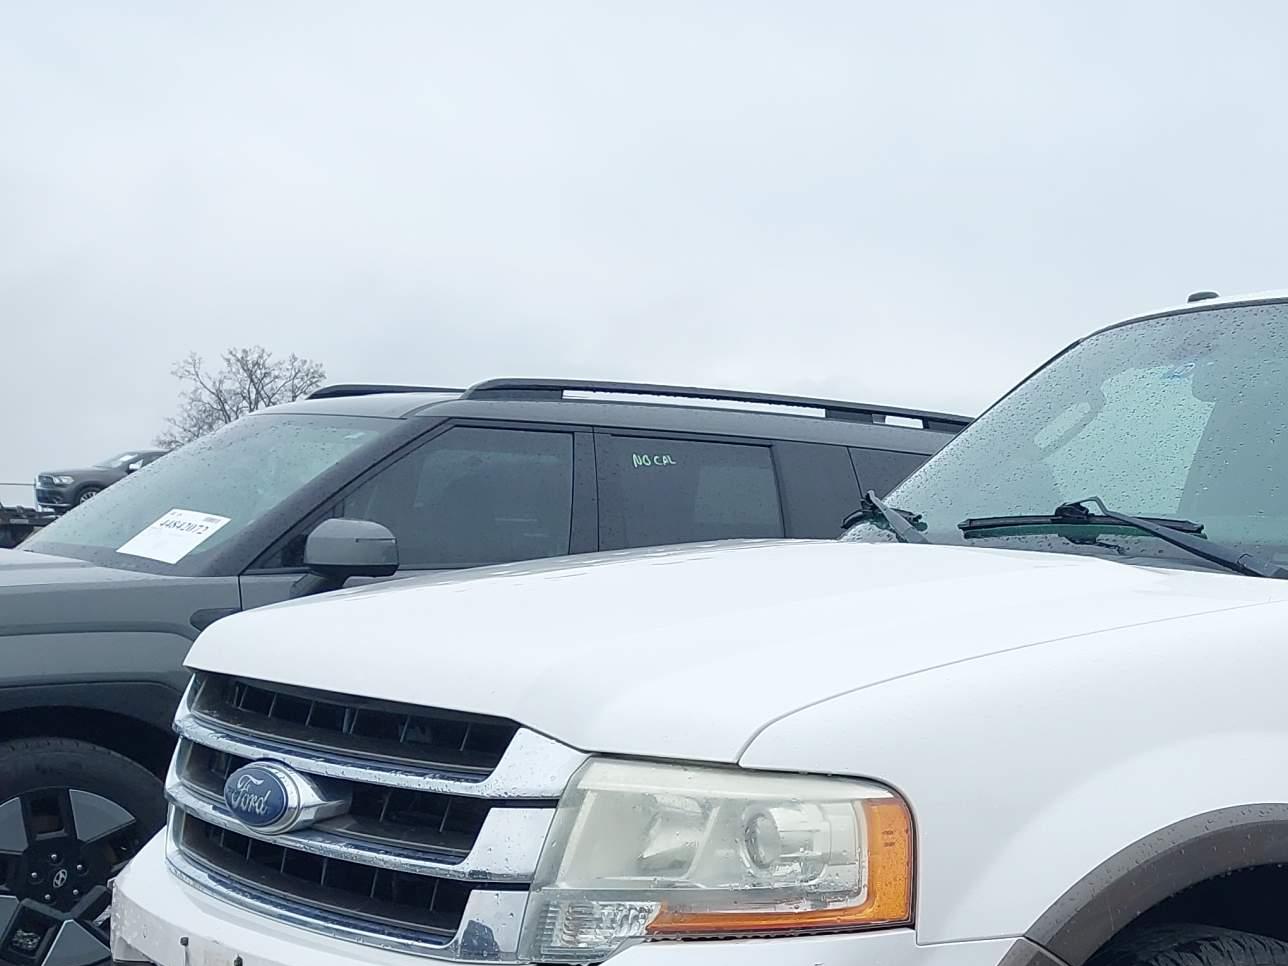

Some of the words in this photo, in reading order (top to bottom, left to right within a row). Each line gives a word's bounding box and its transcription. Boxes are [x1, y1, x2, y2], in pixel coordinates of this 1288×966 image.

[632, 453, 652, 468] NO
[653, 455, 677, 466] CAL
[231, 774, 271, 816] Ford
